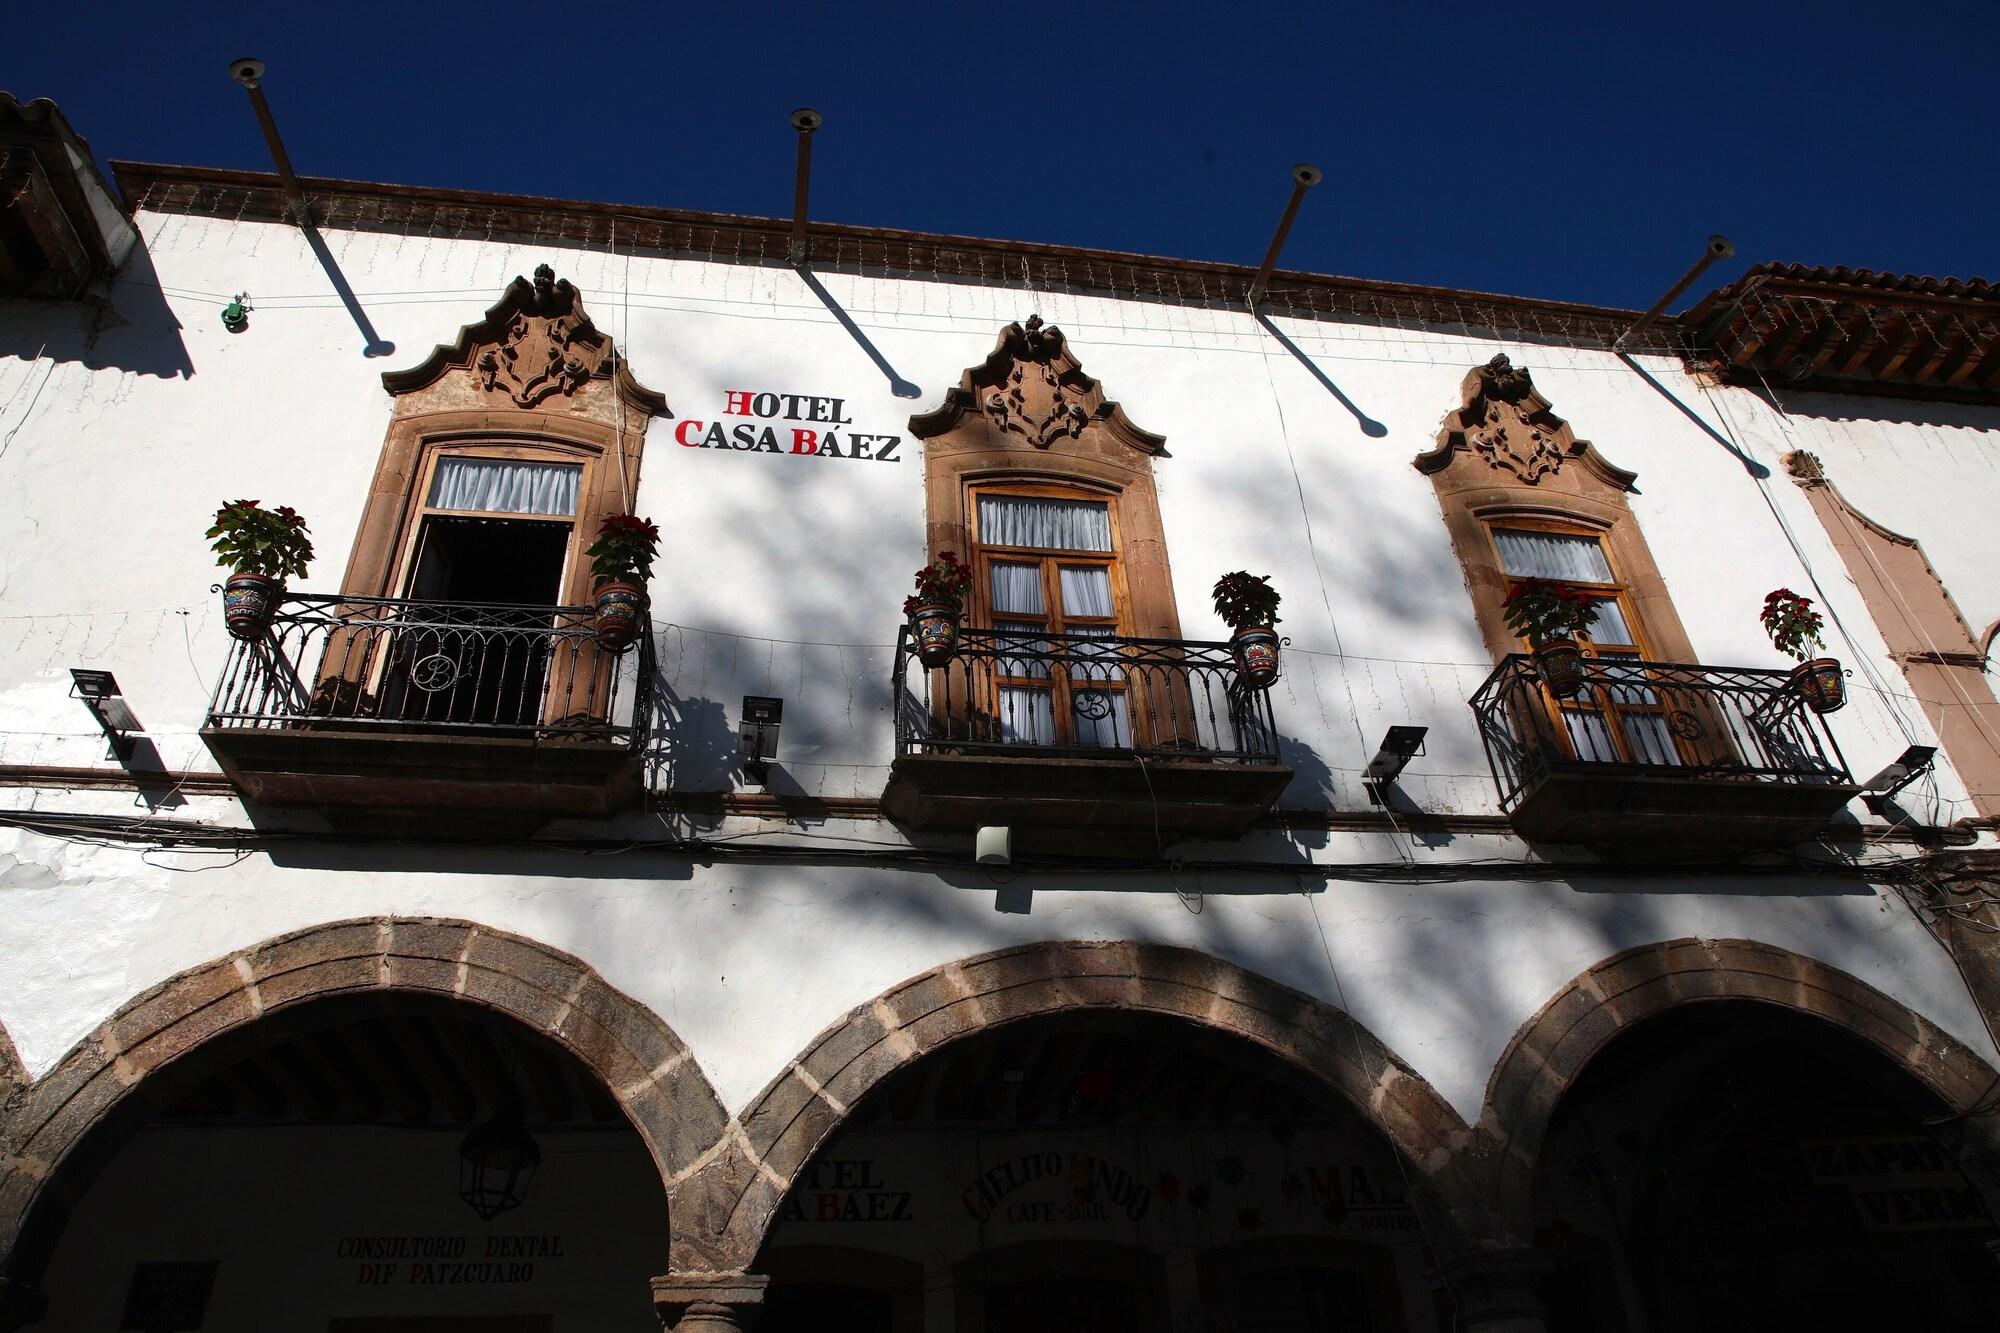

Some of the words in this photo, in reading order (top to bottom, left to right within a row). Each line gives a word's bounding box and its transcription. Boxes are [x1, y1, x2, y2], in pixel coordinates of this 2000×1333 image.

[723, 391, 852, 424] HOTEL
[675, 420, 784, 454] CASA
[789, 425, 901, 463] BÁEZ
[961, 1152, 1062, 1223] CIELITO
[815, 1190, 912, 1223] BÁEZ
[336, 1236, 466, 1258] CONSULTORIO
[485, 1236, 563, 1258] DENTAL
[353, 1263, 396, 1286] DIF
[408, 1263, 533, 1284] PATZCUARO
